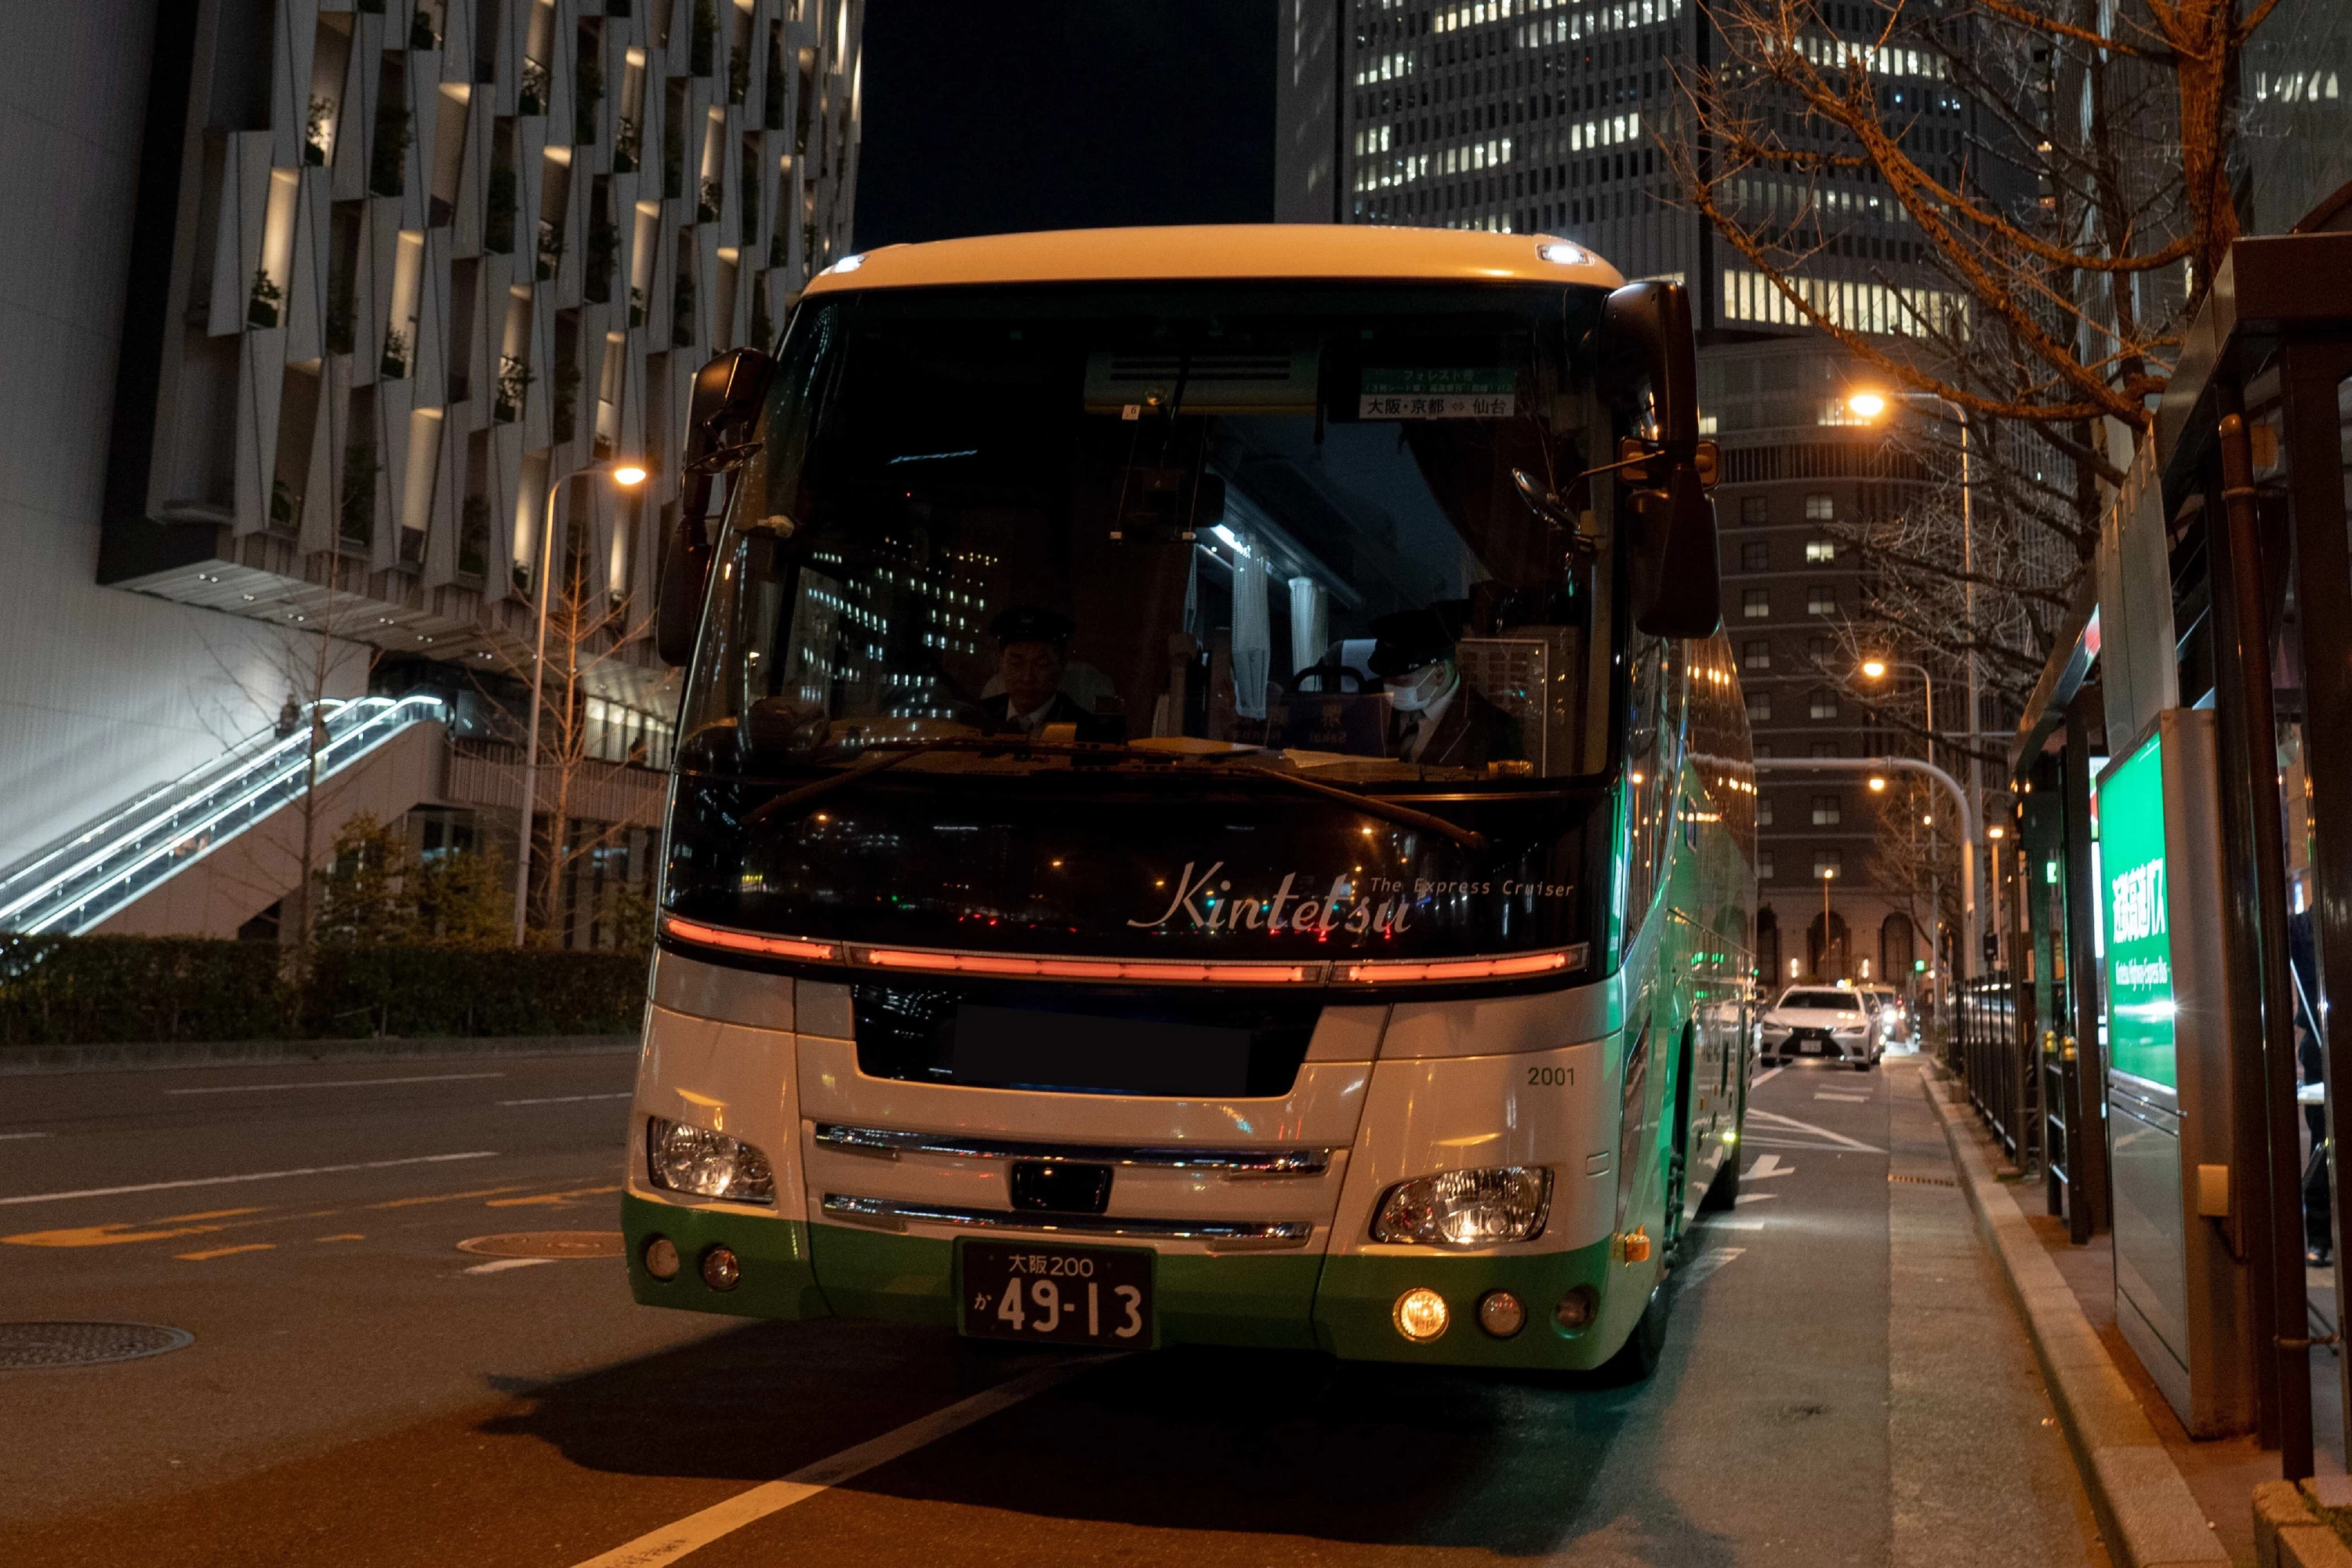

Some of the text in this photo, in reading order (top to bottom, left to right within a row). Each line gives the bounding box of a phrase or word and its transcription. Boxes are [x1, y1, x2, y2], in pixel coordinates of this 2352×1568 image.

[1367, 397, 1507, 415] 大阪・京都 仙台
[1127, 860, 1414, 934] Kintetsu
[1371, 876, 1575, 898] The Express Cruiser
[1527, 1066, 1576, 1087] 2001
[975, 1277, 1142, 1339] か 49-13
